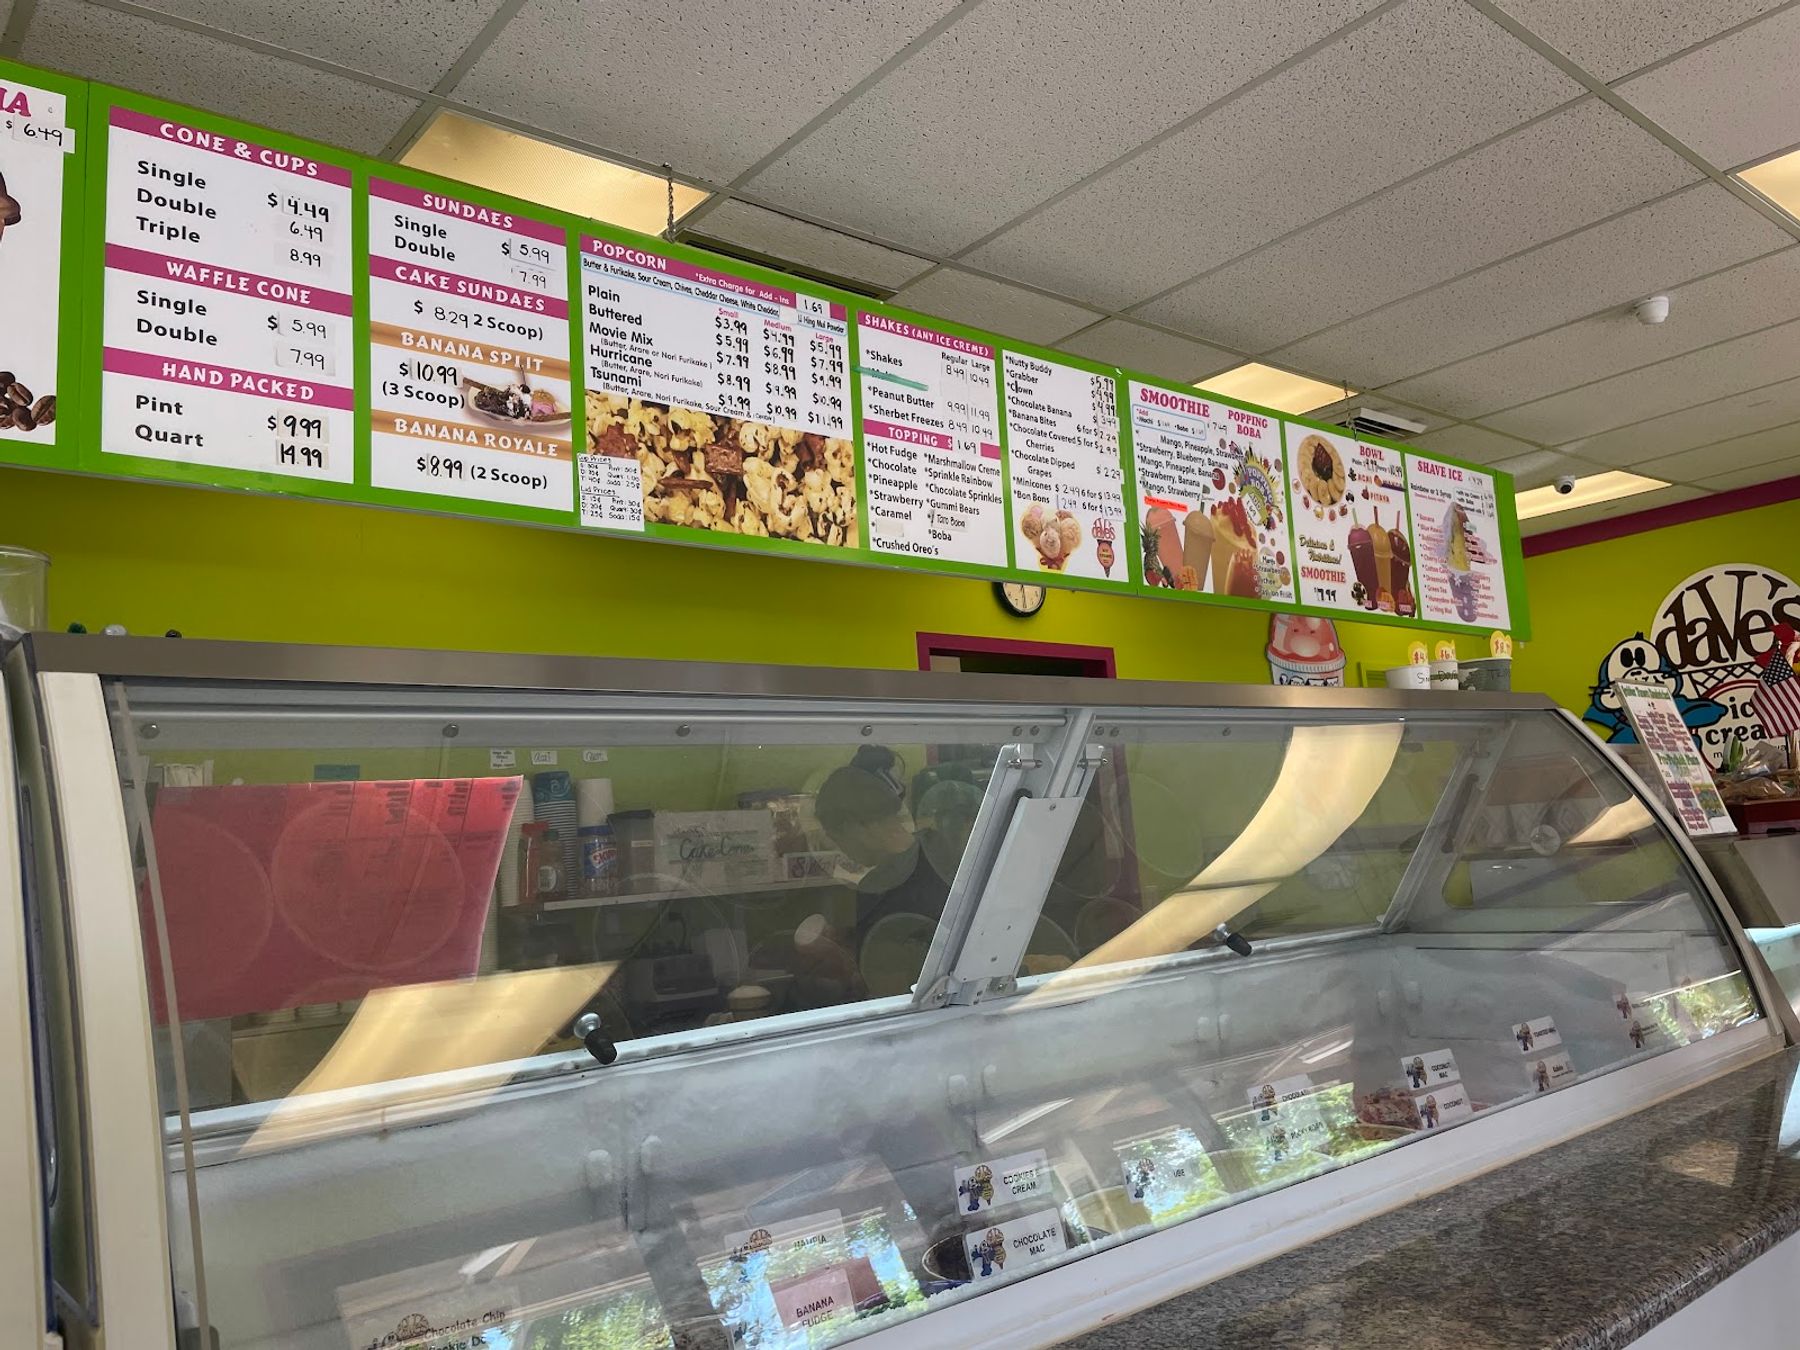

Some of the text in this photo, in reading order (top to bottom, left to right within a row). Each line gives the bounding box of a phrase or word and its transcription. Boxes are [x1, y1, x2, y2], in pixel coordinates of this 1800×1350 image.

[160, 122, 318, 176] CONE & CUPS
[137, 160, 206, 189] Single
[137, 188, 323, 242] Double 6.49
[423, 194, 513, 228] SUNDAES
[394, 215, 447, 239] Single
[136, 216, 321, 268] Triple 8.99
[394, 235, 456, 262] Double
[592, 239, 667, 271] POPCORN
[718, 278, 744, 294] Charge
[759, 289, 773, 301] Add
[166, 261, 311, 305] WAFFLE CONE
[395, 266, 545, 312] CAKE SUNDAES
[137, 290, 207, 316] Single
[136, 318, 217, 346] Double
[487, 317, 543, 341] Scoop)
[588, 284, 842, 360] Plain $3.99 $5.99
[718, 307, 834, 342] Small Medium Large
[401, 331, 484, 361] BANANA
[589, 303, 843, 374] Buttered $5.99 $6.99 $7.99
[865, 314, 989, 357] SHAKES (ANY ICE CREME)
[589, 321, 627, 340] Movie
[631, 331, 654, 346] Mix
[716, 351, 749, 369] $7.99
[764, 362, 796, 380] $8.99
[590, 344, 653, 367] Hurricane
[717, 373, 751, 393] $8.99
[941, 352, 990, 372] Regular Large
[1030, 361, 1052, 377] Buddy
[162, 362, 314, 400] HAND PACKED
[590, 366, 642, 387] Tsunami
[136, 395, 183, 416] Pint
[382, 381, 465, 409] (3 Scoop)
[906, 394, 935, 409] Butter
[1140, 388, 1210, 418] SMOOTHIE
[911, 412, 944, 428] Freezes
[1047, 404, 1073, 418] Banana
[1228, 410, 1268, 429] POPPING
[135, 424, 203, 447] Quart
[394, 418, 558, 457] BANANA ROYALE
[887, 426, 938, 447] TOPPING
[1040, 417, 1057, 428] Bites
[1082, 425, 1093, 436] for
[1237, 424, 1261, 439] BOBA
[1025, 438, 1055, 453] Cherries
[1048, 431, 1077, 445] Covered
[1083, 438, 1093, 449] for
[1160, 435, 1214, 456] Mango, Pineapple,
[889, 446, 918, 461] Fudge
[978, 463, 1000, 477] Creme
[1050, 457, 1075, 470] Dipped
[1176, 451, 1206, 466] Blueberry,
[1207, 457, 1229, 470] Banana
[1359, 445, 1385, 461] BOWL
[470, 465, 486, 479] (2
[491, 468, 548, 490] Scoop)
[1027, 465, 1052, 478] Grapes
[1165, 460, 1197, 476] Pineapple,
[1417, 460, 1463, 482] SHAVE ICE
[961, 473, 993, 488] Rainbow
[1178, 475, 1200, 488] Banana
[968, 490, 1002, 505] Sprinkles
[1032, 493, 1098, 513] Bons for
[1086, 490, 1097, 500] for
[959, 503, 980, 516] Bears
[912, 542, 939, 556] Oreo's
[1301, 566, 1346, 583] SMOOTHIE
[1011, 1182, 1037, 1195] CREAM
[1013, 1227, 1057, 1249] CHOCOLATE
[1029, 1244, 1046, 1256] MAC
[796, 1295, 834, 1318] BANANA
[424, 1310, 506, 1342] Chocolate Chip
[801, 1310, 834, 1327] FUDGE
